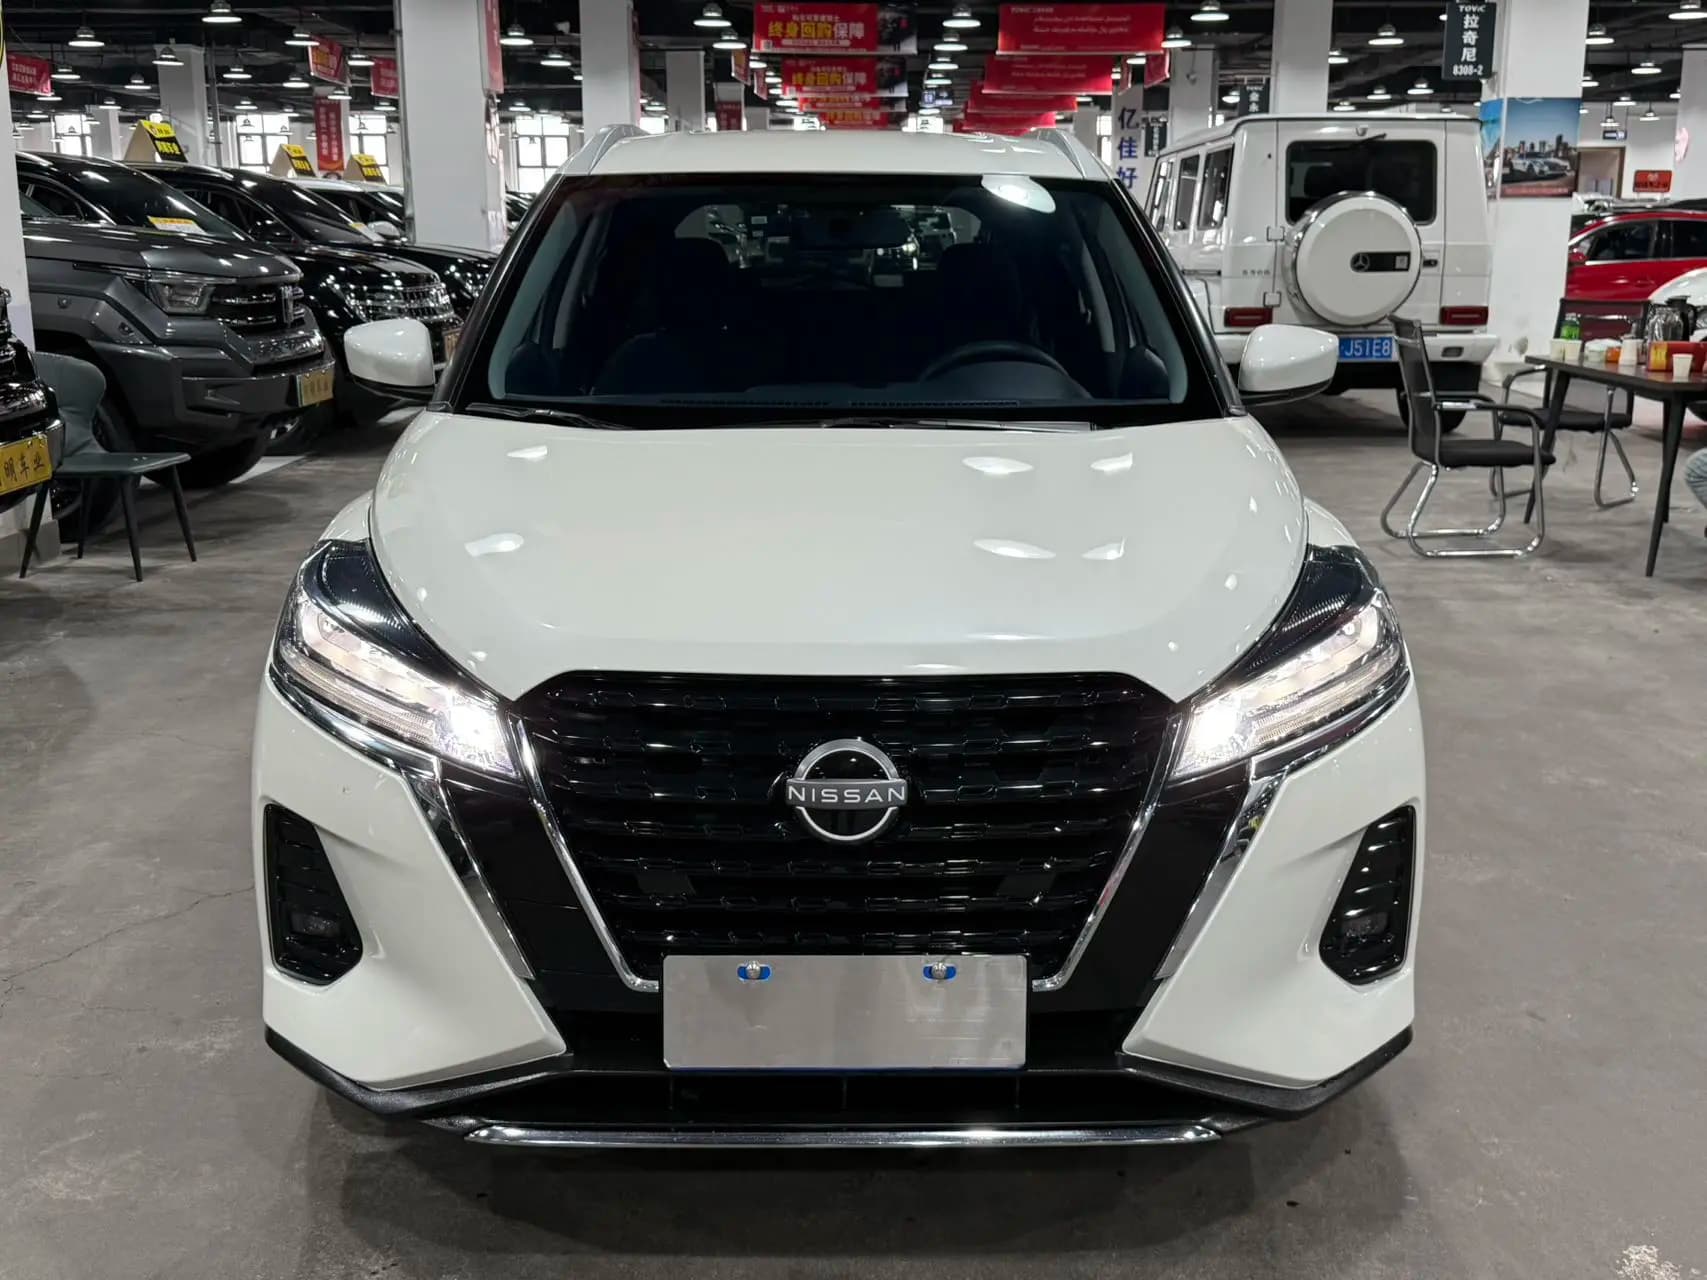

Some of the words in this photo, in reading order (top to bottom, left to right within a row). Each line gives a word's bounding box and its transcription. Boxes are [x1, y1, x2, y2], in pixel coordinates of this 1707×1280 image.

[1117, 107, 1139, 189] 亿佳好
[0, 452, 45, 487] 明车业
[788, 785, 905, 803] NISSAN
